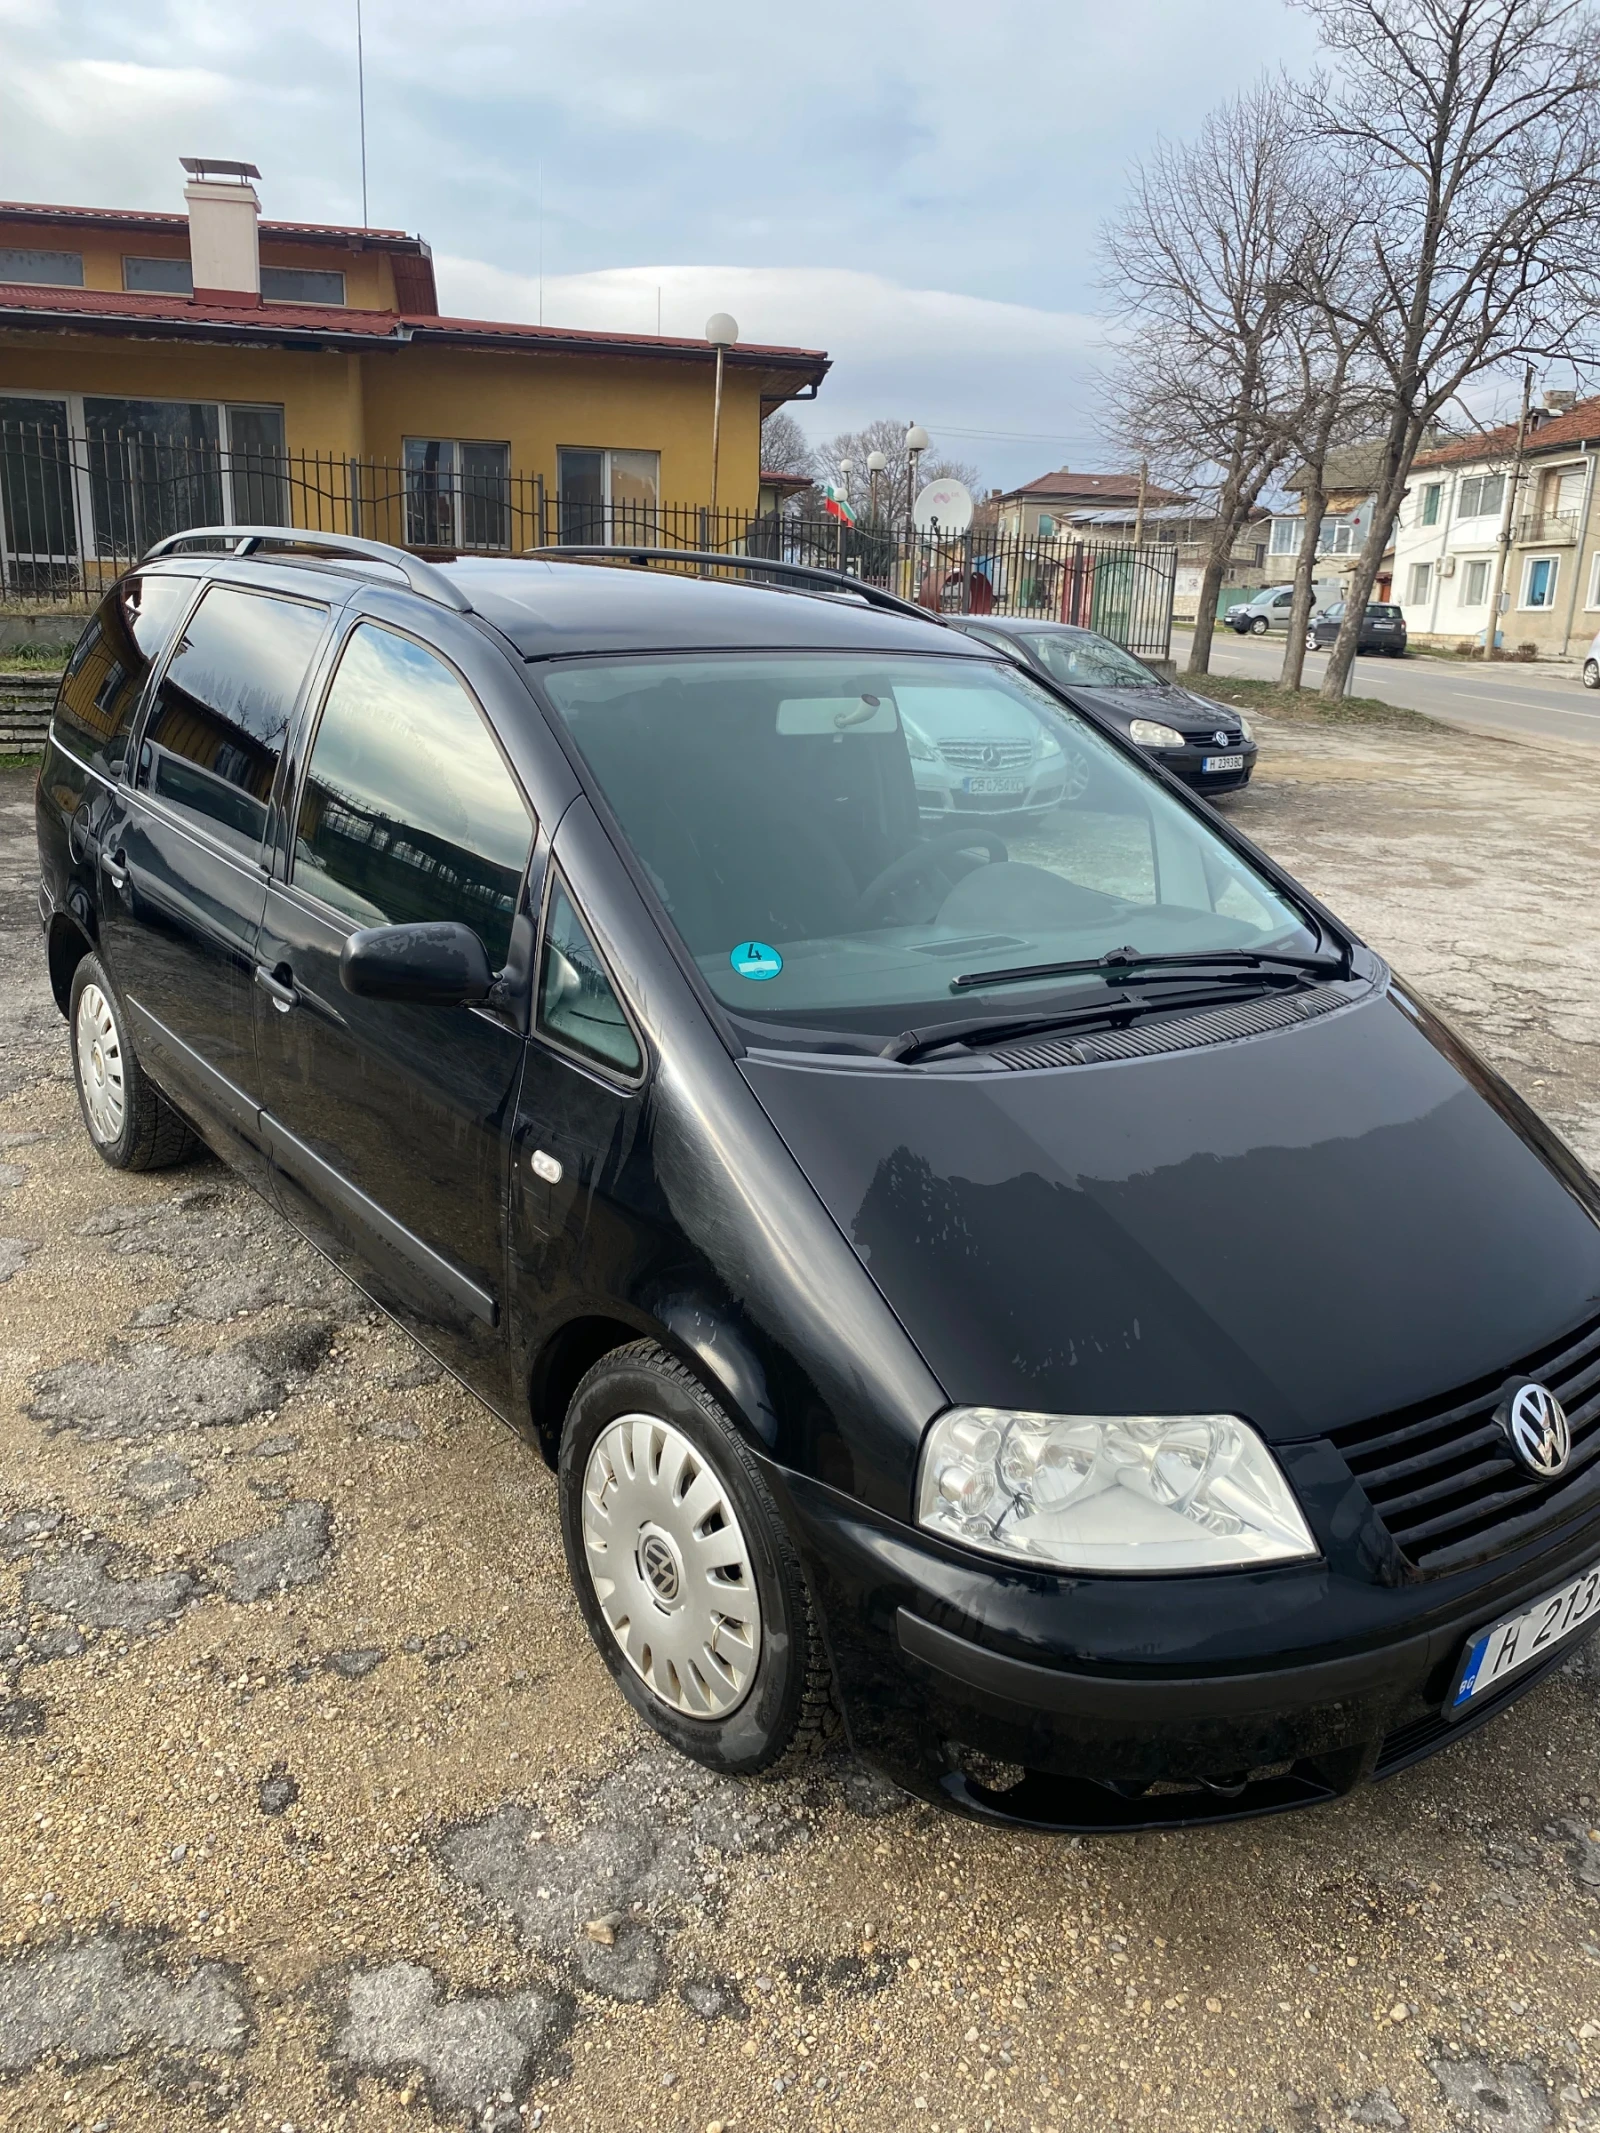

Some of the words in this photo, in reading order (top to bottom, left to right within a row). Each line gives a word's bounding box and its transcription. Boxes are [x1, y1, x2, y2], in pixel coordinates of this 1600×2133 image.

[1210, 759, 1215, 770] H
[747, 944, 762, 960] 4
[1492, 1626, 1521, 1675] H
[1532, 1573, 1600, 1649] 213
[1459, 1675, 1475, 1694] BG
